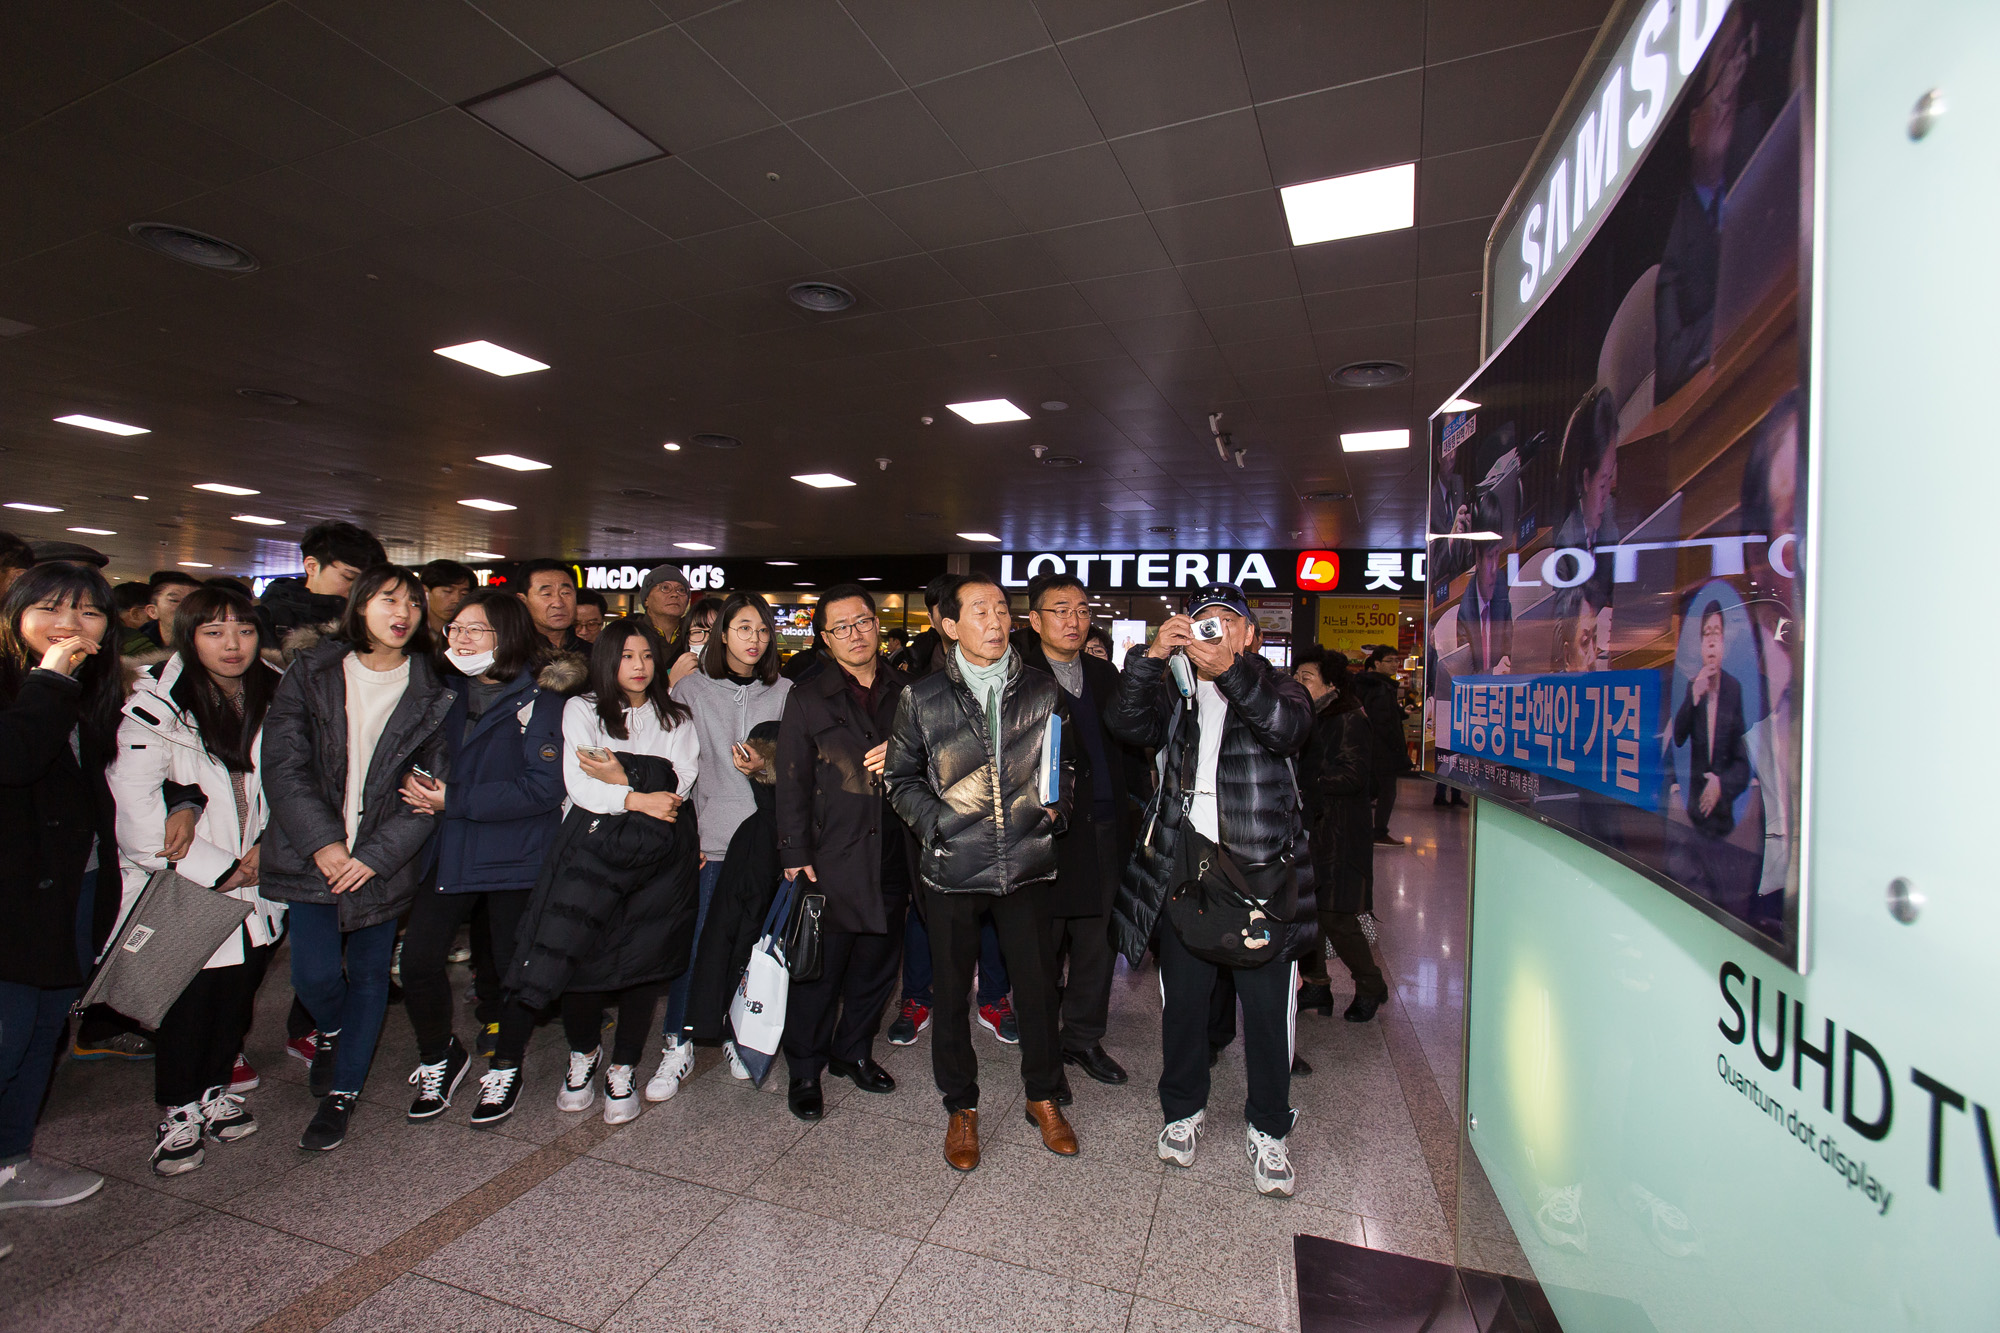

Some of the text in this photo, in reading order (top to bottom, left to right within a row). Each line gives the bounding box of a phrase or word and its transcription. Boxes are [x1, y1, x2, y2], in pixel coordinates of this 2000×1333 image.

[1001, 553, 1276, 588] LOTTERIA
[1453, 683, 1641, 793] 대통령 탄핵안 가결
[1509, 771, 1521, 790] 위해
[1521, 774, 1540, 798] 총력전
[1718, 961, 1894, 1142] SUHD
[1717, 1053, 1893, 1216] Quantum dot display
